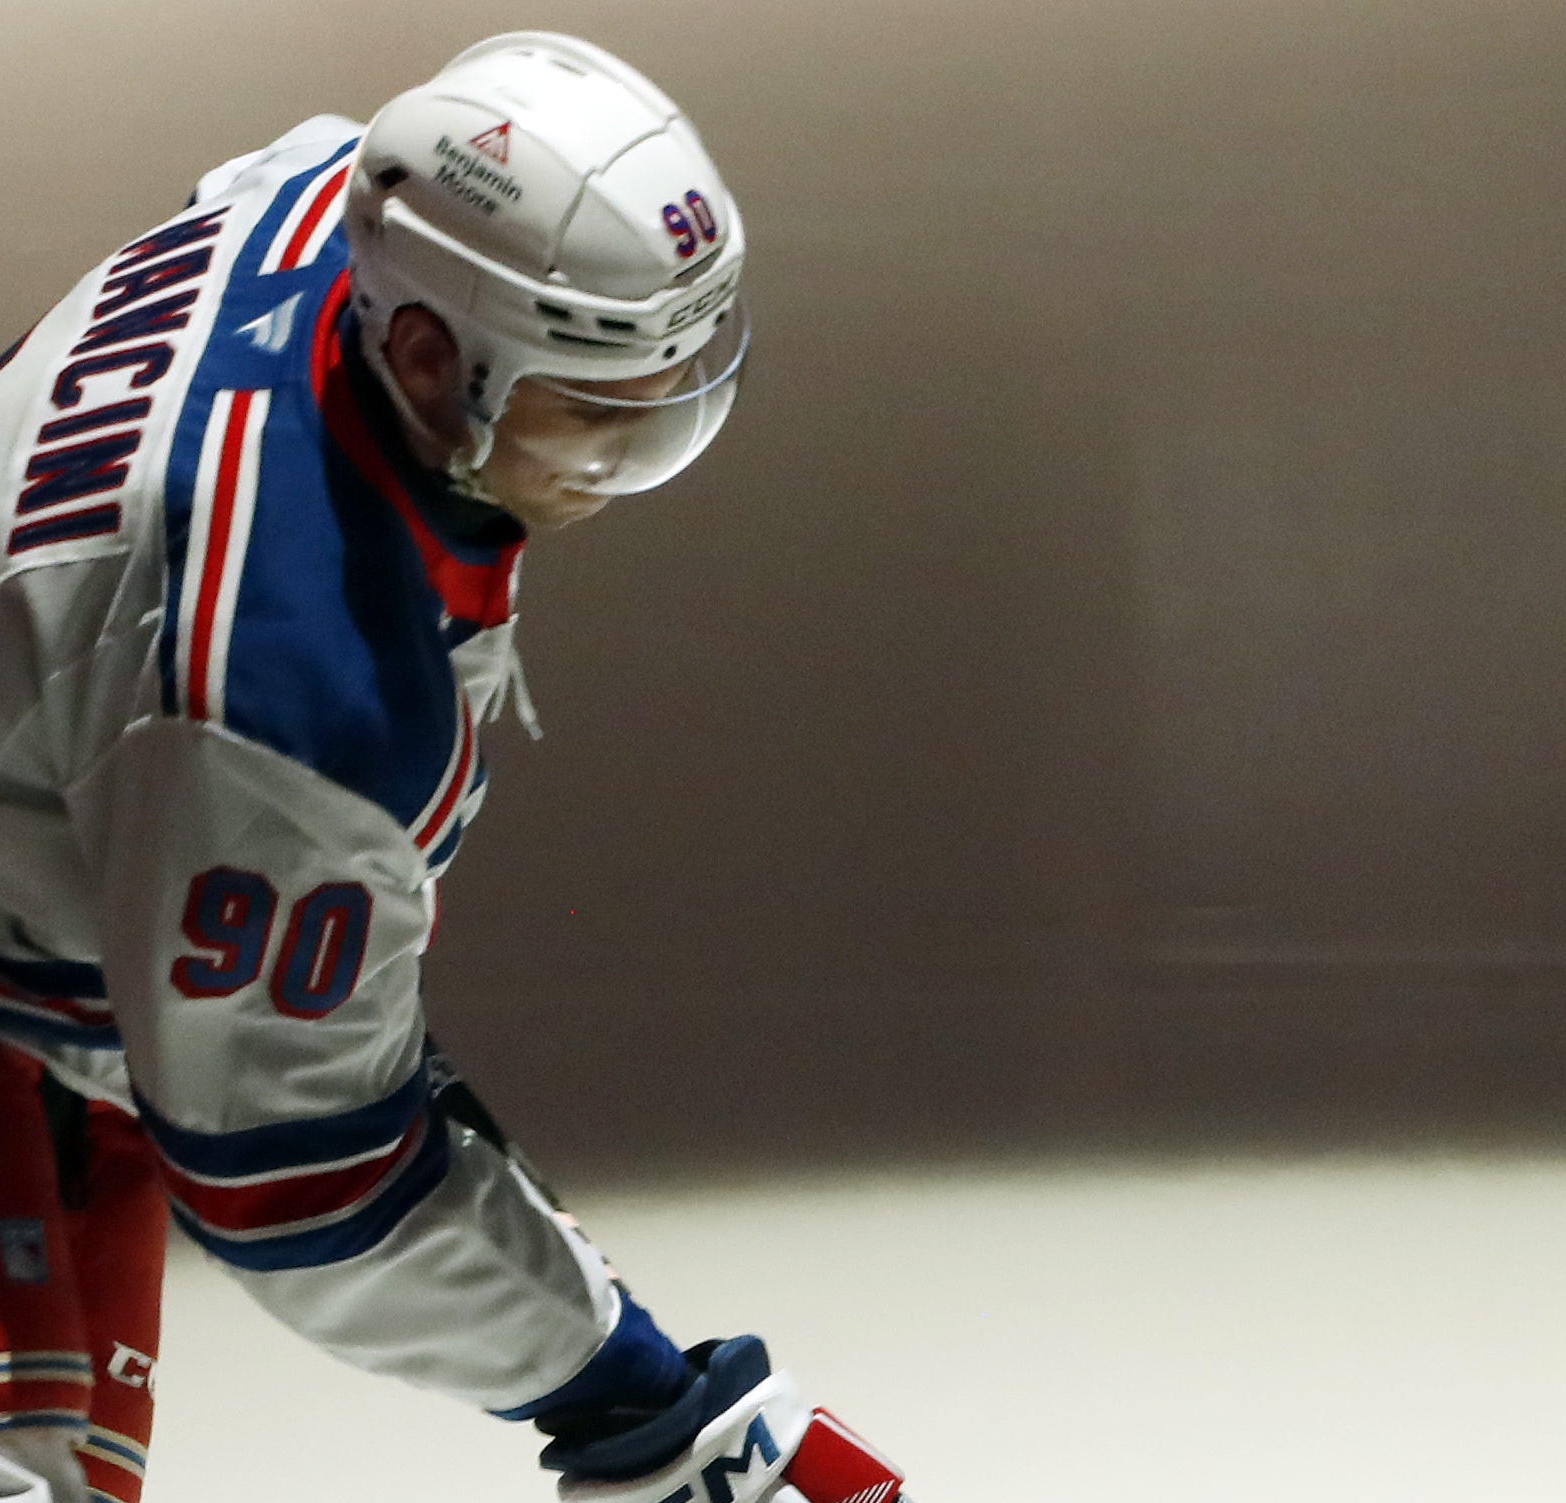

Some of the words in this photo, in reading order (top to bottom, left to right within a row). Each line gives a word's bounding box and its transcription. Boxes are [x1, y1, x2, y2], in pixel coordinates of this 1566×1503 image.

[435, 134, 523, 202] Benjamin
[435, 164, 498, 216] Moore
[662, 189, 717, 259] 90
[7, 205, 233, 556] MANCINI
[170, 865, 374, 1021] 90
